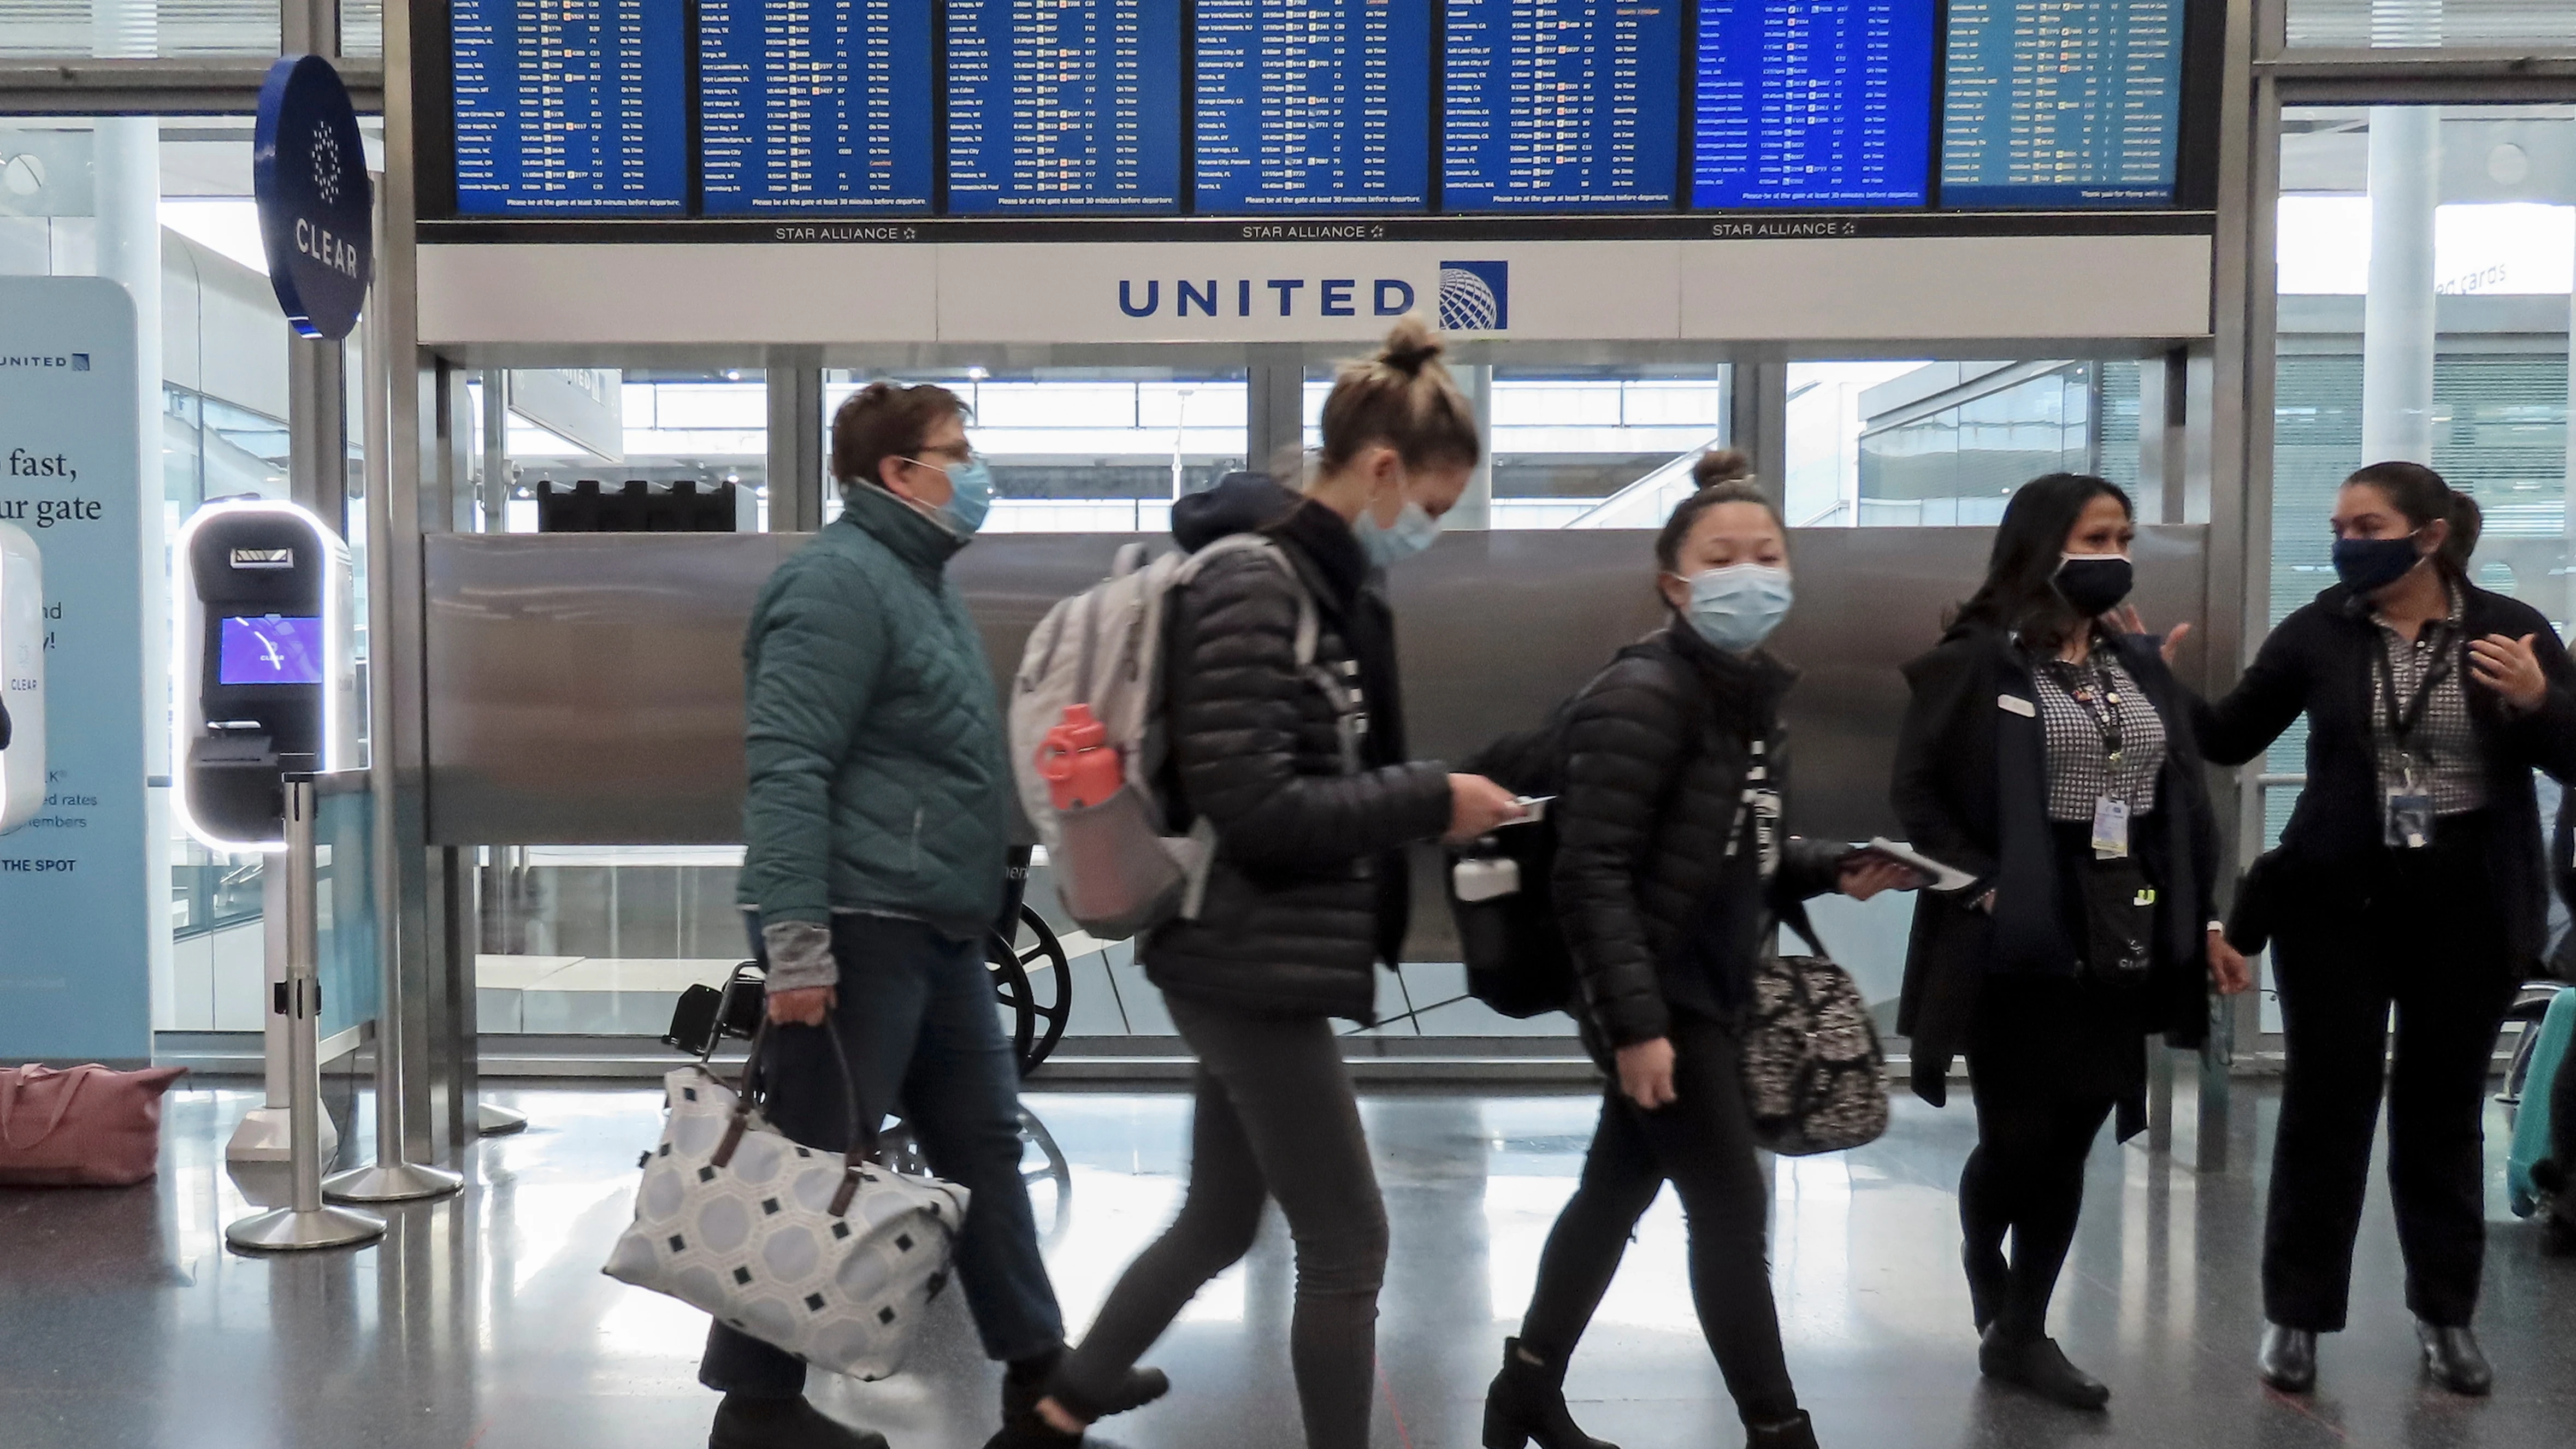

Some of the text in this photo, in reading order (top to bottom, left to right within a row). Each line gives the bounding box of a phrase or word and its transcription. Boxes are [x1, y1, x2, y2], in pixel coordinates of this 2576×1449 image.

[776, 227, 897, 240] STAR ALLIANCE
[1243, 226, 1365, 238] STAR ALLIANCE
[1712, 222, 1836, 236] STAR ALLIANCE
[295, 217, 357, 278] CLEAR
[1119, 279, 1415, 317] UNITED
[0, 357, 67, 367] UNITED
[9, 448, 77, 483] fast,
[37, 497, 102, 528] gate
[11, 678, 37, 691] CLEAR
[62, 795, 98, 806] rates
[29, 816, 87, 827] embers
[2, 859, 76, 872] THE SPOT
